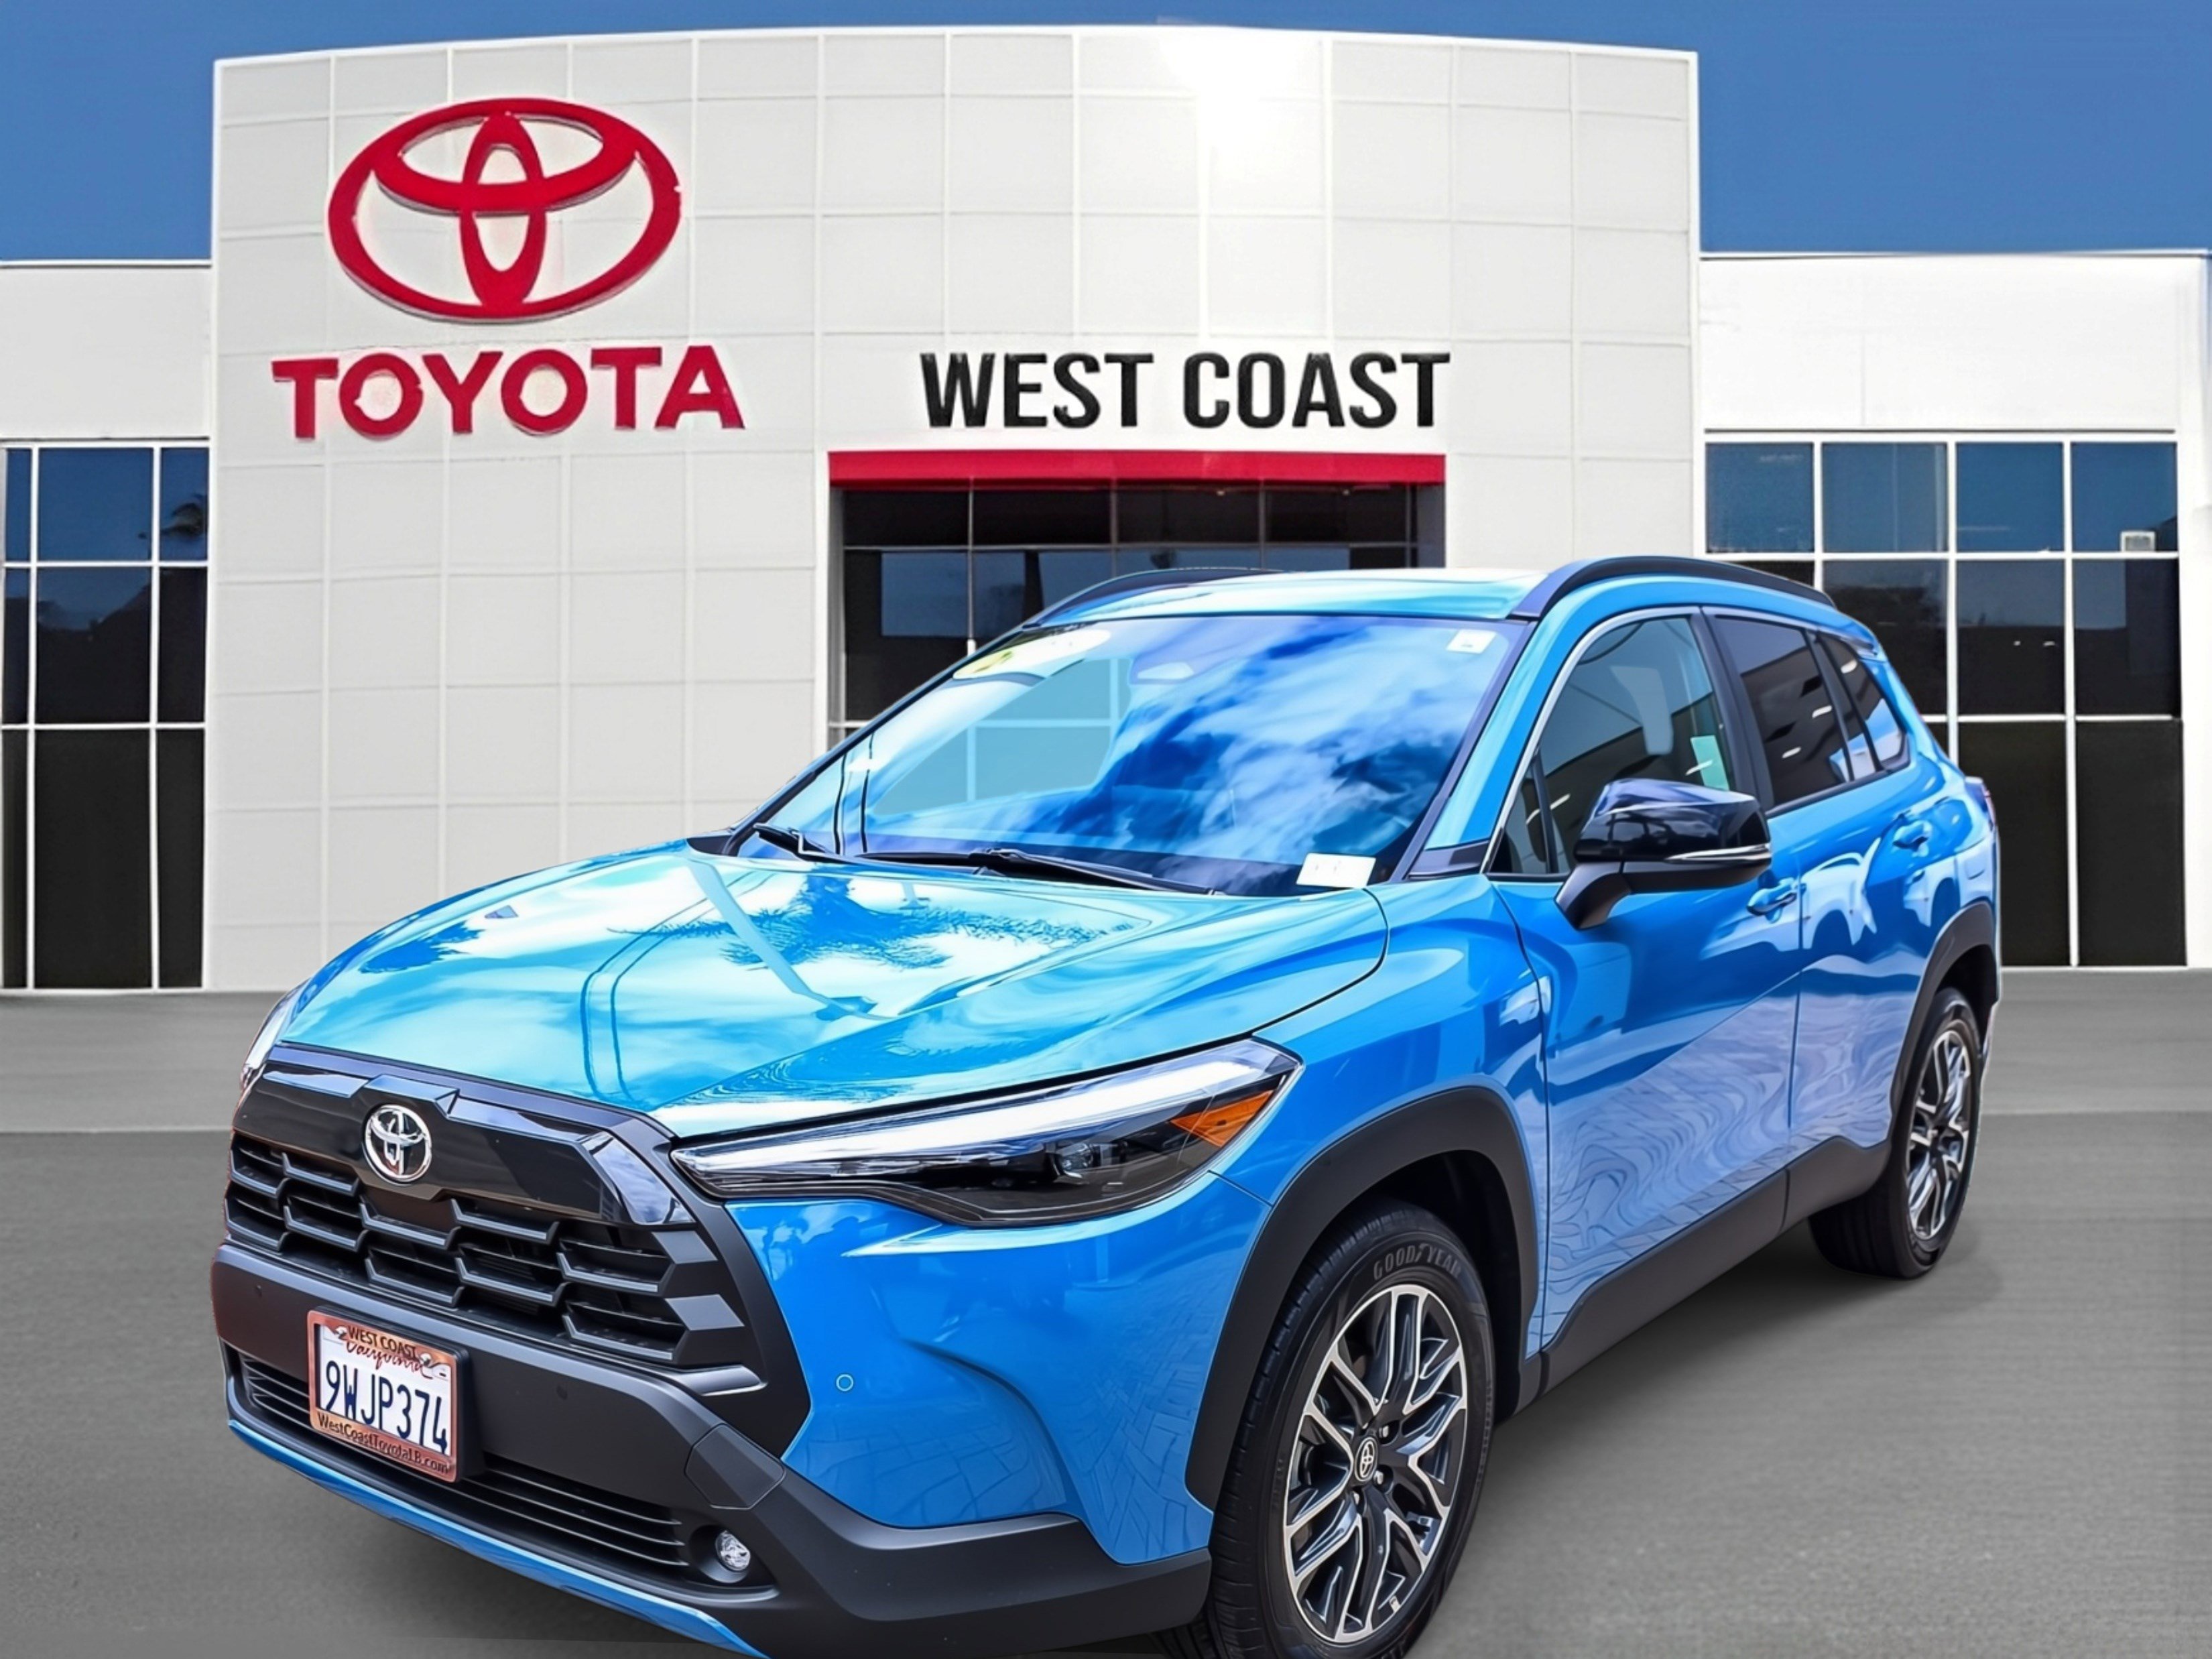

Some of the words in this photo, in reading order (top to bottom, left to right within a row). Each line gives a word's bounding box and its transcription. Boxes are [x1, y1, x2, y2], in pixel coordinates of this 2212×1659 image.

[271, 345, 746, 441] TOYOTA
[920, 352, 1154, 429] WEST
[1183, 352, 1451, 429] COAST
[1373, 1243, 1462, 1281] GOODYEAR
[348, 1326, 377, 1347] WEST
[379, 1336, 417, 1359] COAST
[326, 1360, 448, 1455] 9WJP374
